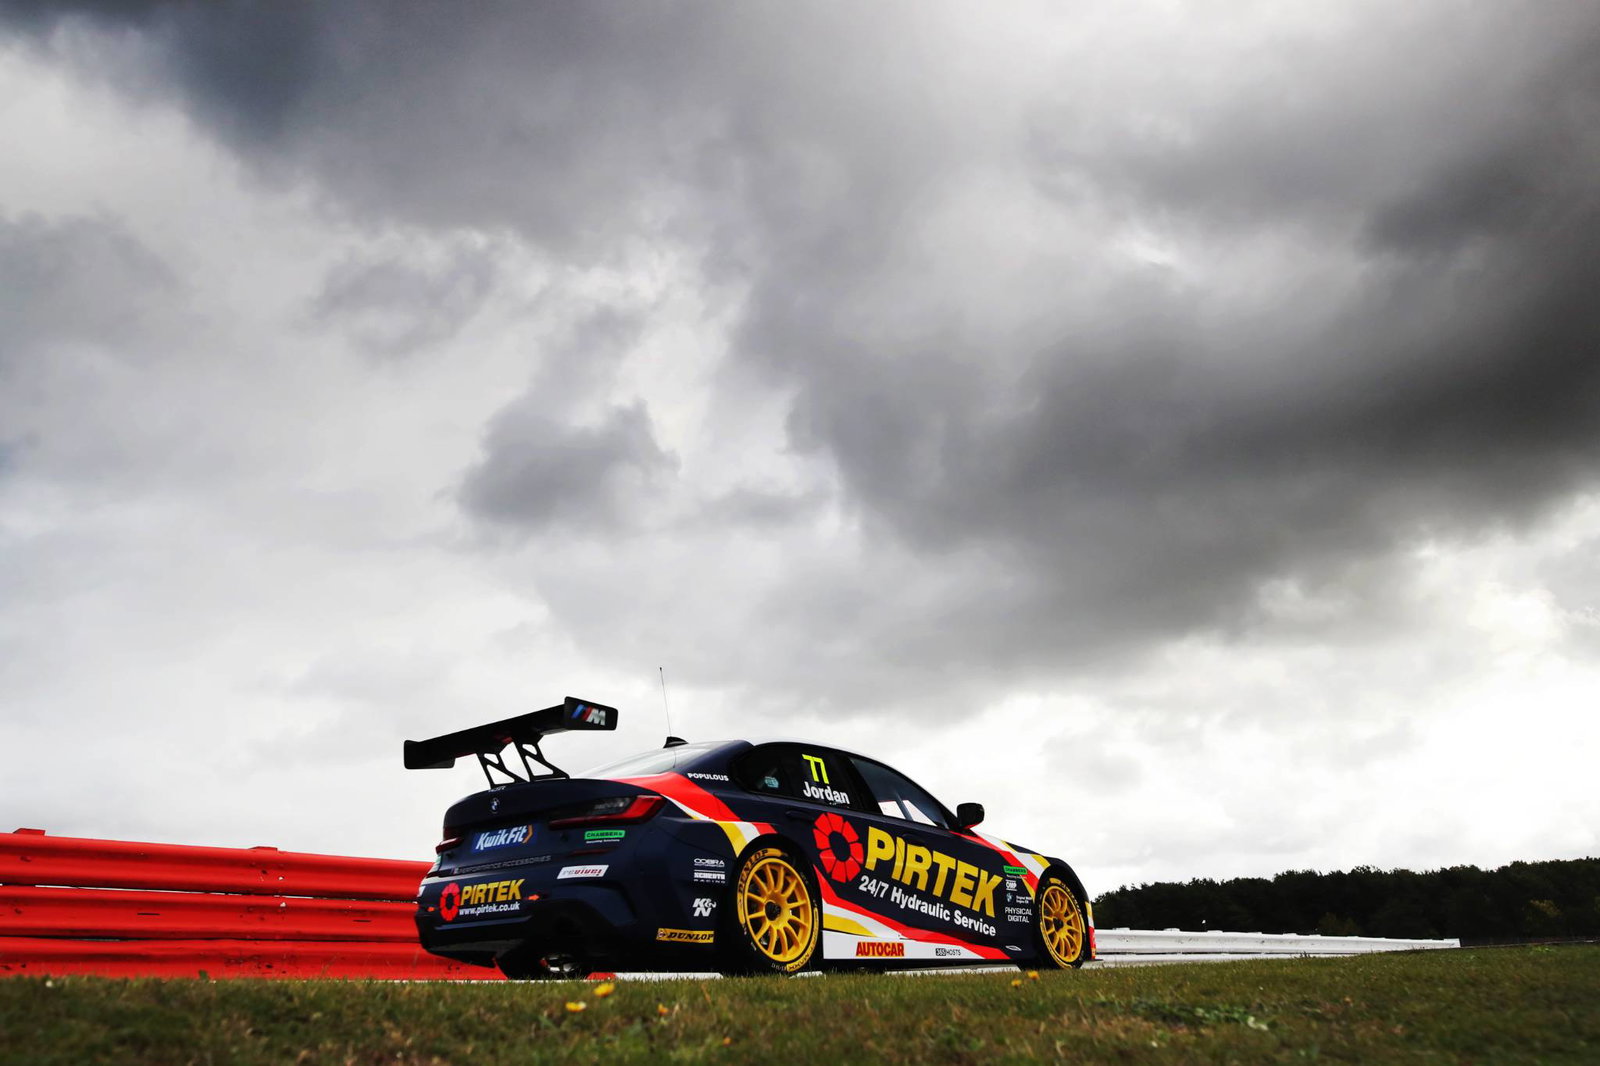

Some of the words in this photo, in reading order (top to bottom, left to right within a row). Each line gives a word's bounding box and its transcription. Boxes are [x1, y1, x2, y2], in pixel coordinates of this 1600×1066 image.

[802, 753, 830, 785] 77
[687, 772, 729, 783] POPULOUS
[803, 781, 851, 805] Jordan
[693, 858, 725, 866] COBRA
[864, 826, 1004, 918] PIRTEK
[460, 879, 526, 906] PIRTEK
[459, 901, 521, 916] www.pirtek.co.uk
[858, 875, 889, 898] 24/7
[890, 886, 951, 921] Hydraulic
[954, 910, 997, 937] Service
[1004, 907, 1033, 915] PHYSICAL
[1007, 915, 1030, 923] DIGITAL
[673, 932, 715, 942] DUNLOP
[856, 941, 905, 957] AUTOCAR
